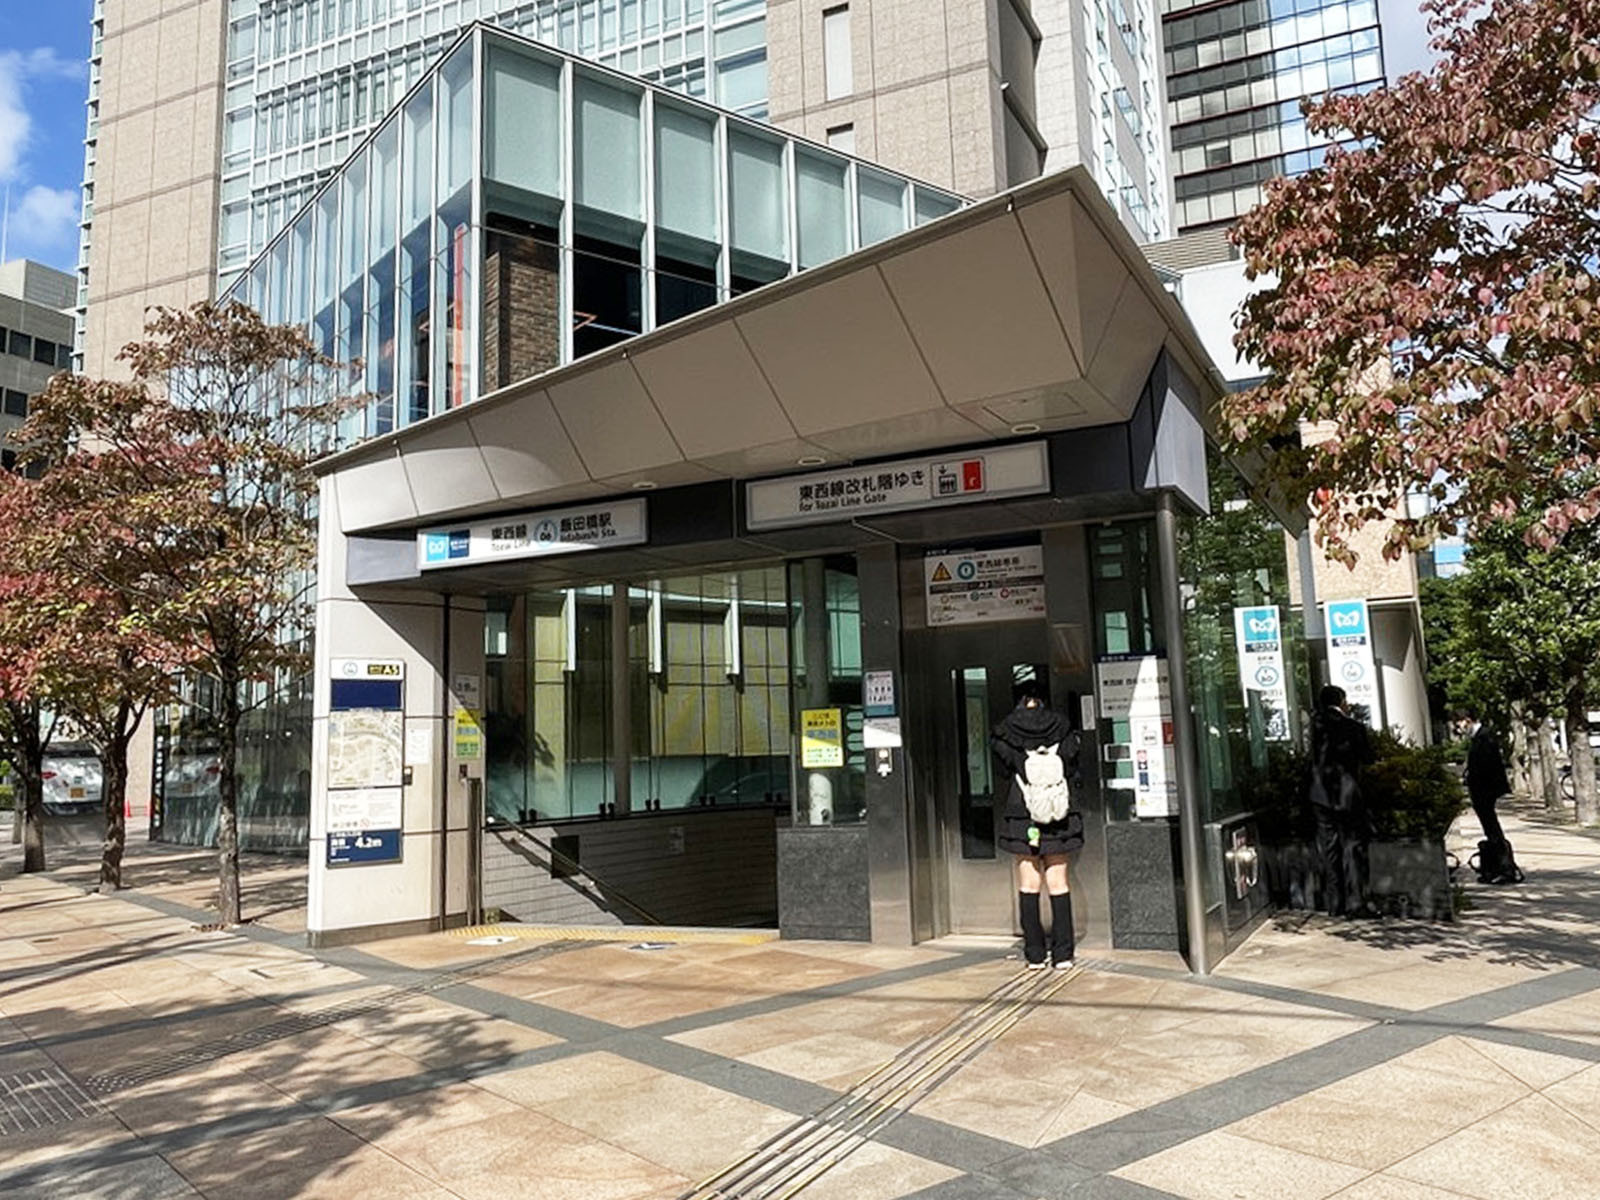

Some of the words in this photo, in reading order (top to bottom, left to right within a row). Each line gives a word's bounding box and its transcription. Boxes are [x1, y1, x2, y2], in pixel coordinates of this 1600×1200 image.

[799, 470, 924, 501] 東西線改札階ゆき
[799, 501, 813, 512] for
[841, 496, 862, 507] Line
[864, 493, 887, 504] Gate
[491, 523, 527, 541] 東西線
[355, 837, 383, 848] 4.2m
